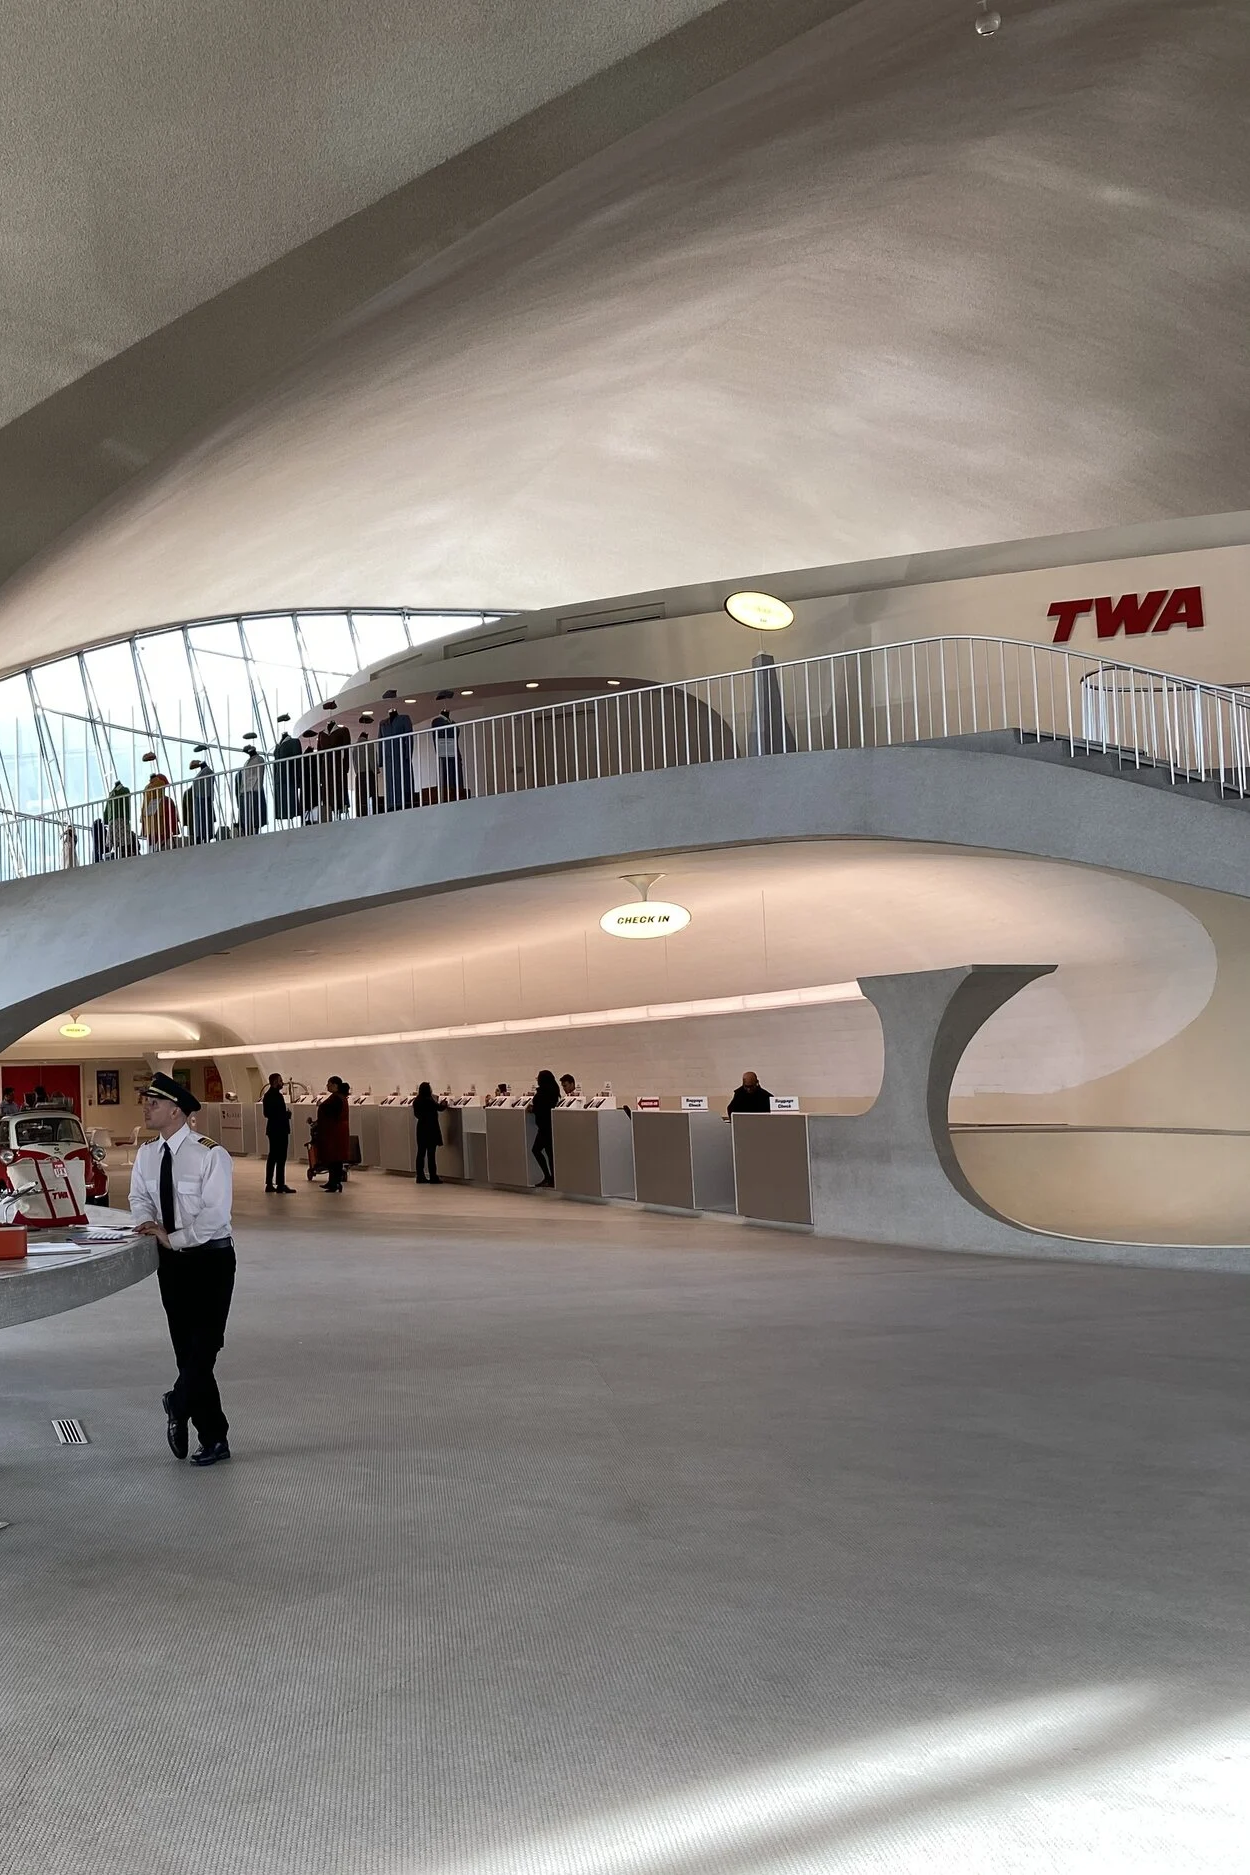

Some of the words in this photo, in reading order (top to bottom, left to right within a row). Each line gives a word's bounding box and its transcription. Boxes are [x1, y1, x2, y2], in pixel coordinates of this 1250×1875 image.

[1047, 586, 1205, 643] TWA
[617, 916, 655, 924] CHECK
[658, 915, 670, 923] IN
[52, 1191, 69, 1200] TWA
